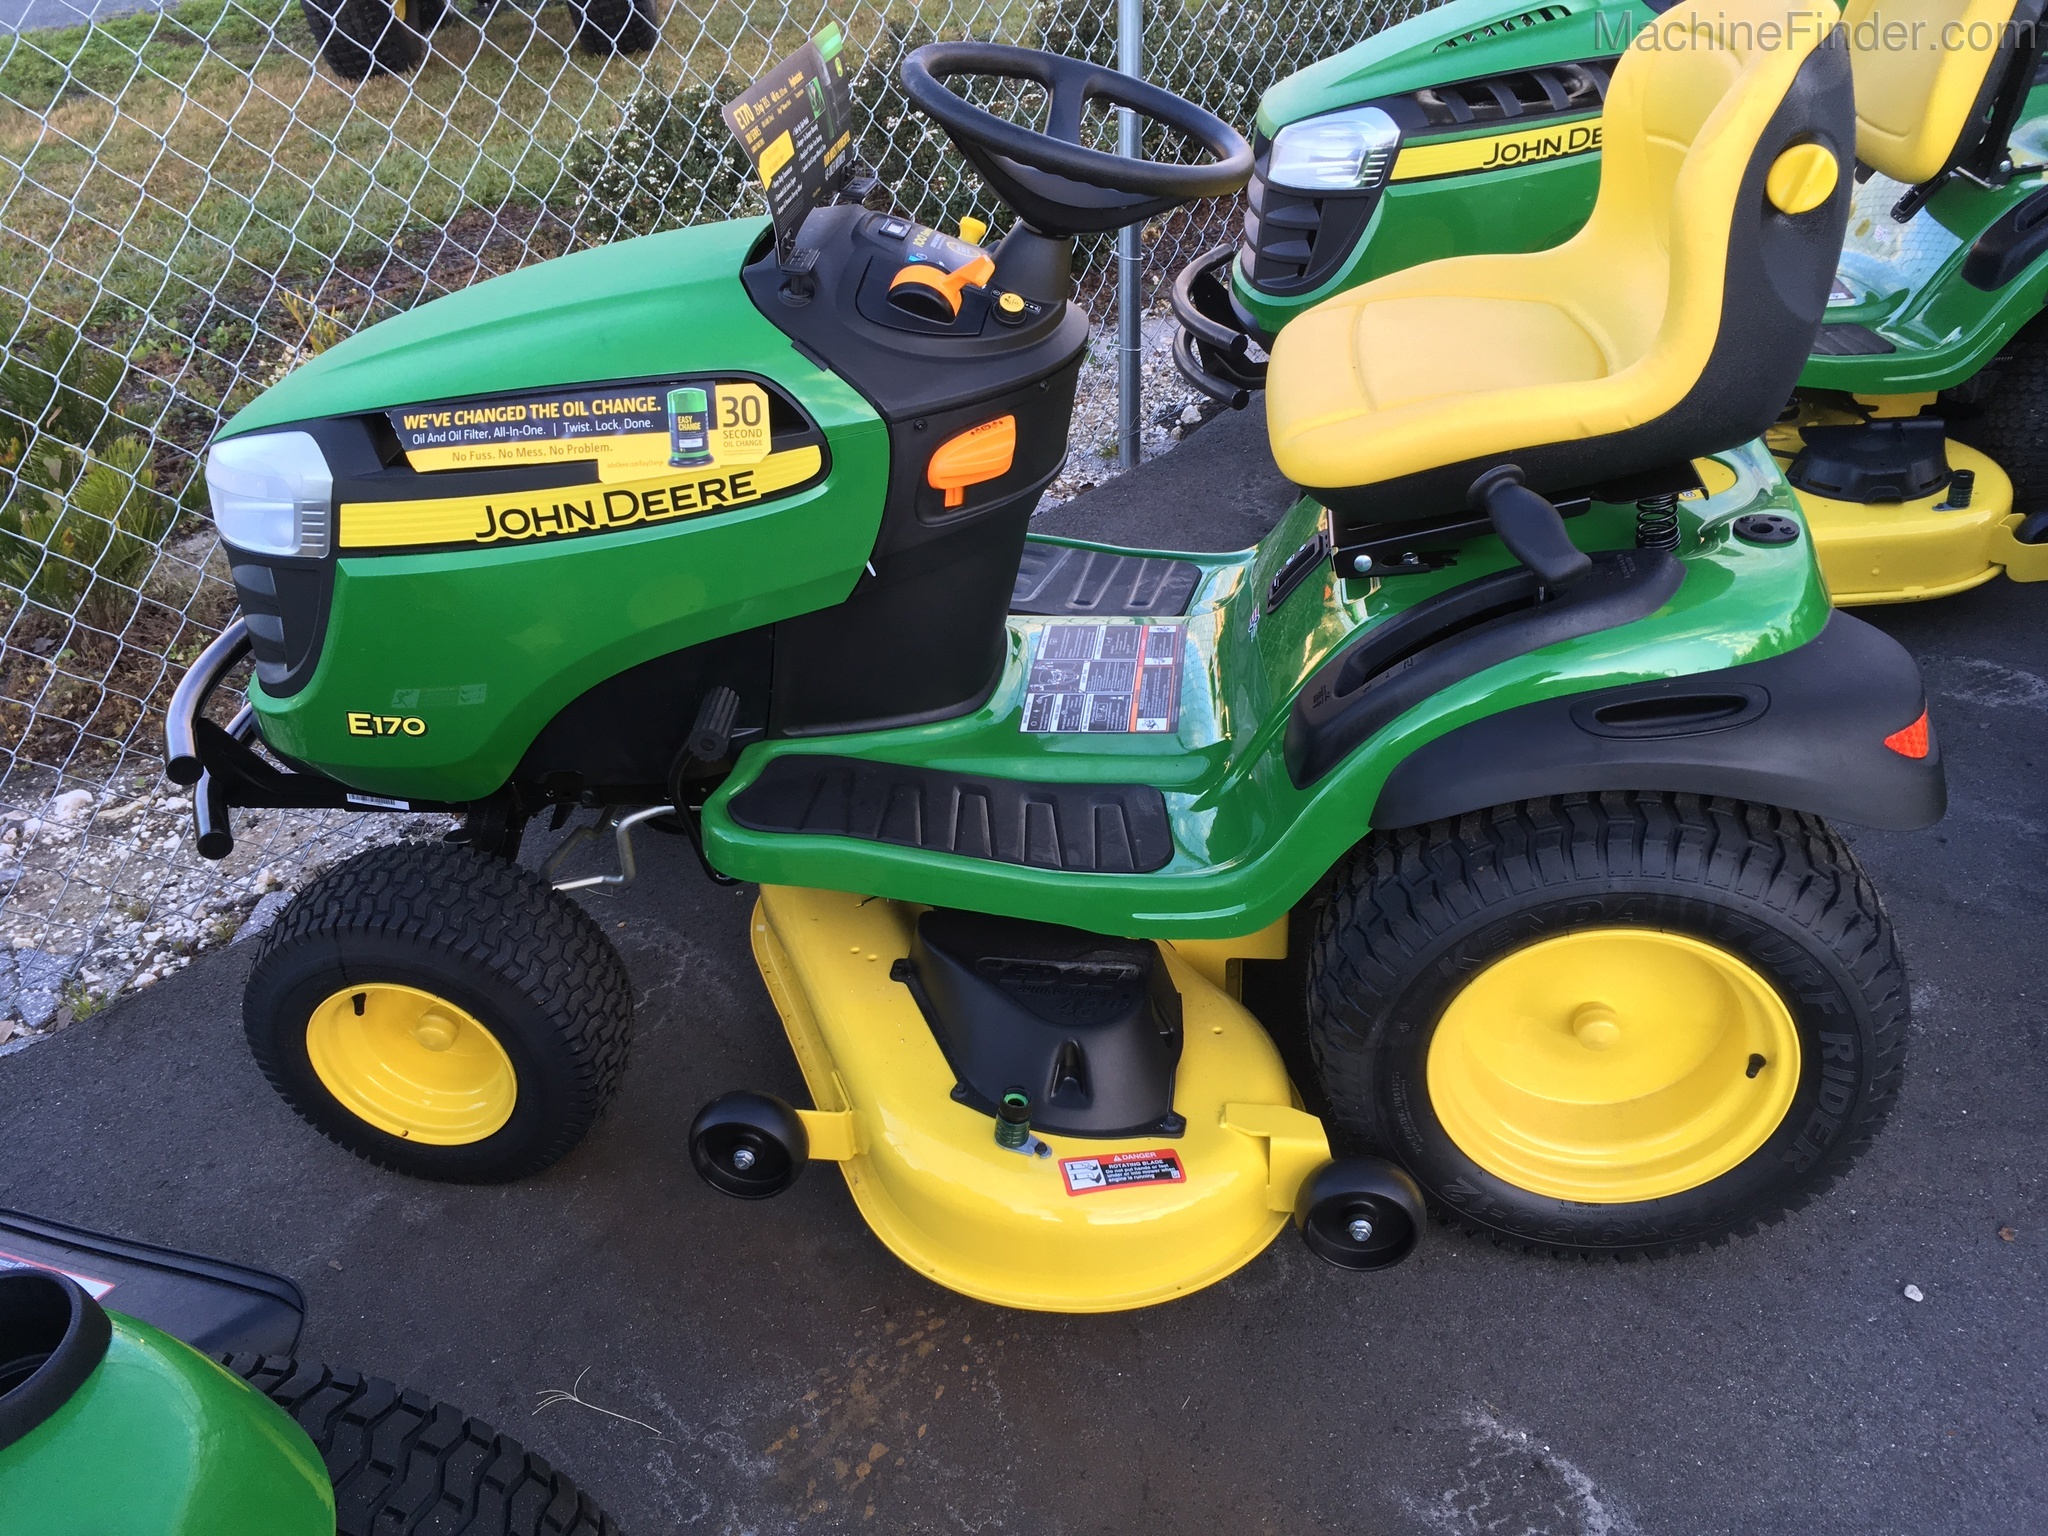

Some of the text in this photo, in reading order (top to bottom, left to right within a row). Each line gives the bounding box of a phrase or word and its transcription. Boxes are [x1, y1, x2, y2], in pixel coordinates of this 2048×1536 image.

[1483, 136, 1561, 166] JOHN
[404, 396, 661, 430] WE'VE CHANGED THE OIL CHANGE.
[722, 395, 761, 427] 30
[412, 418, 654, 444] Oil And Oil Filter, All-In-One. Twist. Lock. Done.
[678, 422, 701, 431] CHANGE
[723, 429, 762, 440] SECOND
[452, 442, 613, 462] No Fuss. No Mess. No Problem.
[475, 470, 756, 538] JOHN DEERE
[347, 712, 427, 737] E170
[1437, 896, 1855, 1173] KENDA TURF RIDER
[1109, 1161, 1141, 1169] ROTATING
[1122, 1152, 1156, 1160] DANGER
